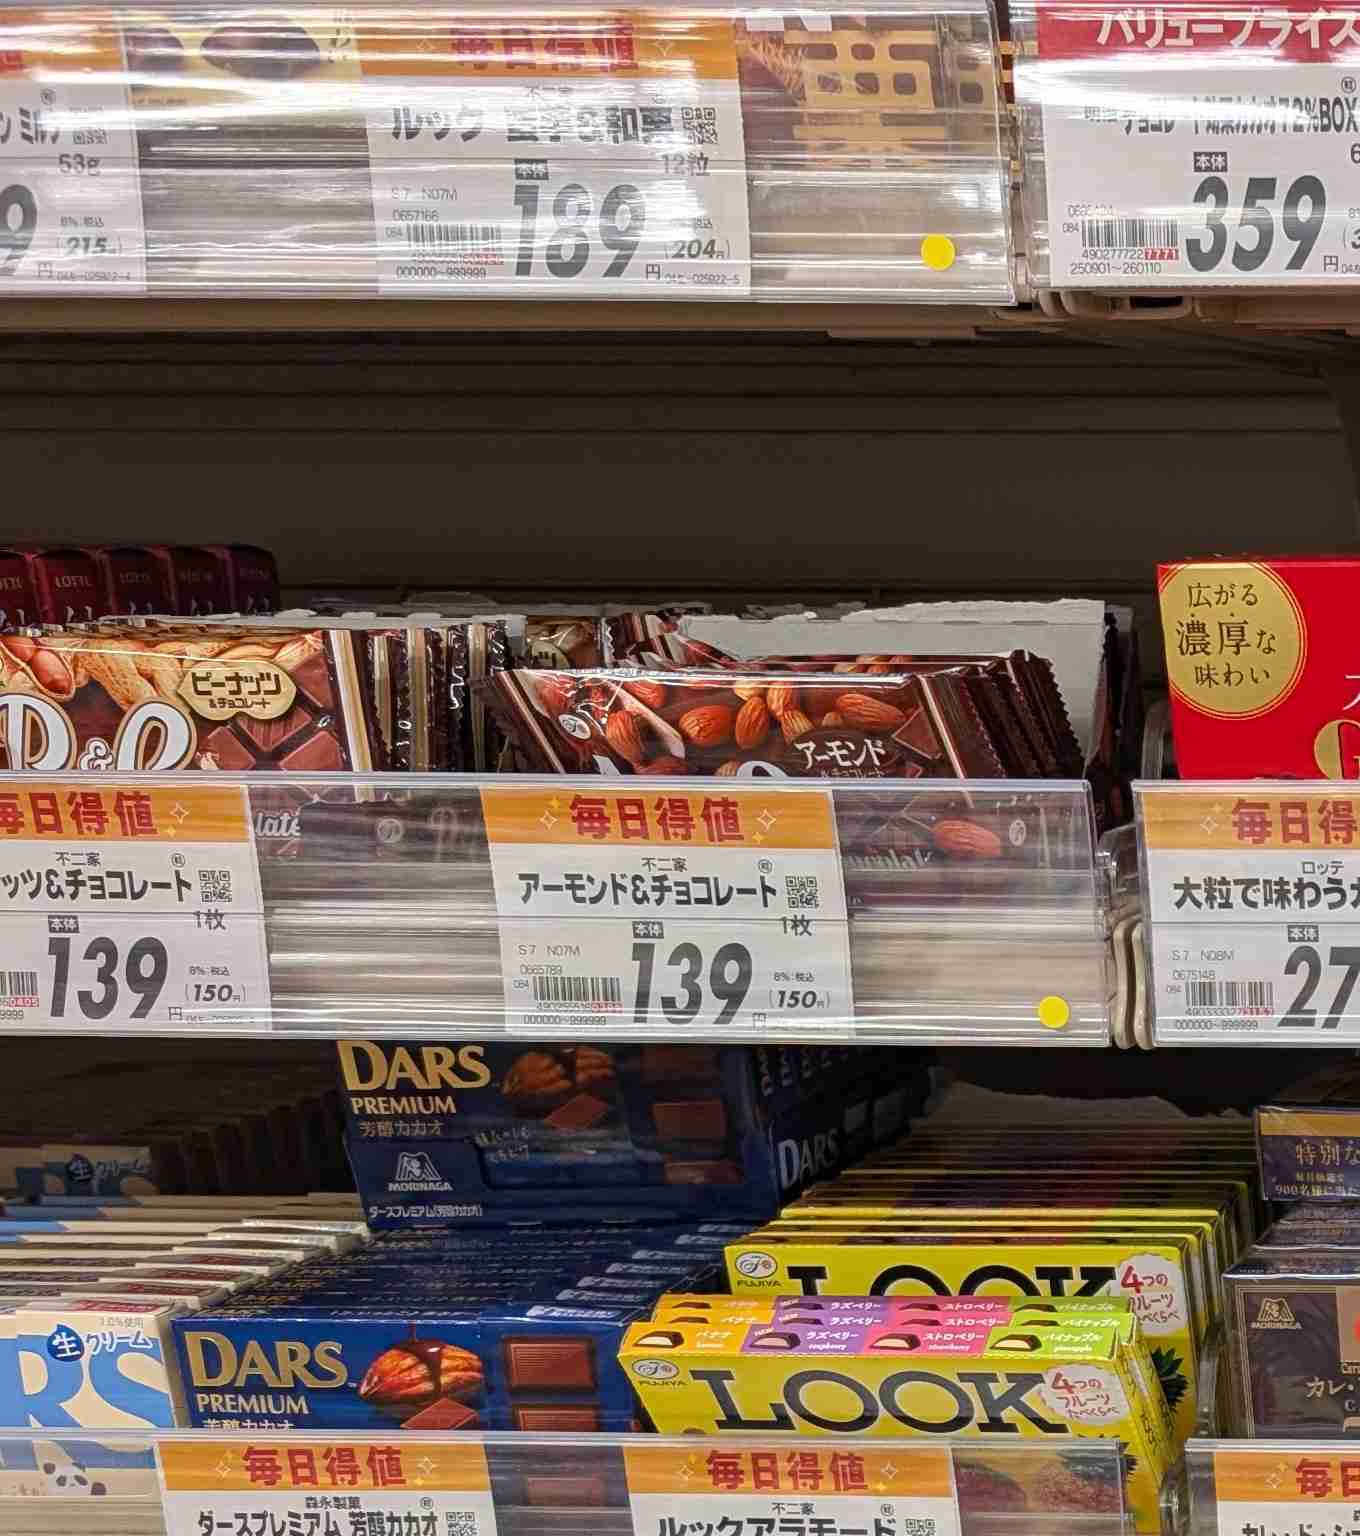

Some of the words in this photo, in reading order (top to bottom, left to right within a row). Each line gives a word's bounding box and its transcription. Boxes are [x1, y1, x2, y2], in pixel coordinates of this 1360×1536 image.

[512, 185, 648, 280] 189
[1184, 175, 1327, 272] 359
[1187, 582, 1258, 610] 広がる
[1177, 618, 1278, 658] 濃厚な
[190, 671, 280, 696] ピーナッツ
[1194, 663, 1271, 688] 味わい
[642, 857, 688, 873] 不二家
[517, 873, 777, 909] アーモンド&チョコレート
[780, 915, 812, 937] 1枚
[48, 936, 168, 1020] 139
[631, 941, 753, 1026] 139
[351, 1096, 456, 1116] PREMIUM
[183, 1330, 348, 1390] DARS
[196, 1394, 309, 1416] PREMIUM
[690, 1368, 1069, 1436] LOOK
